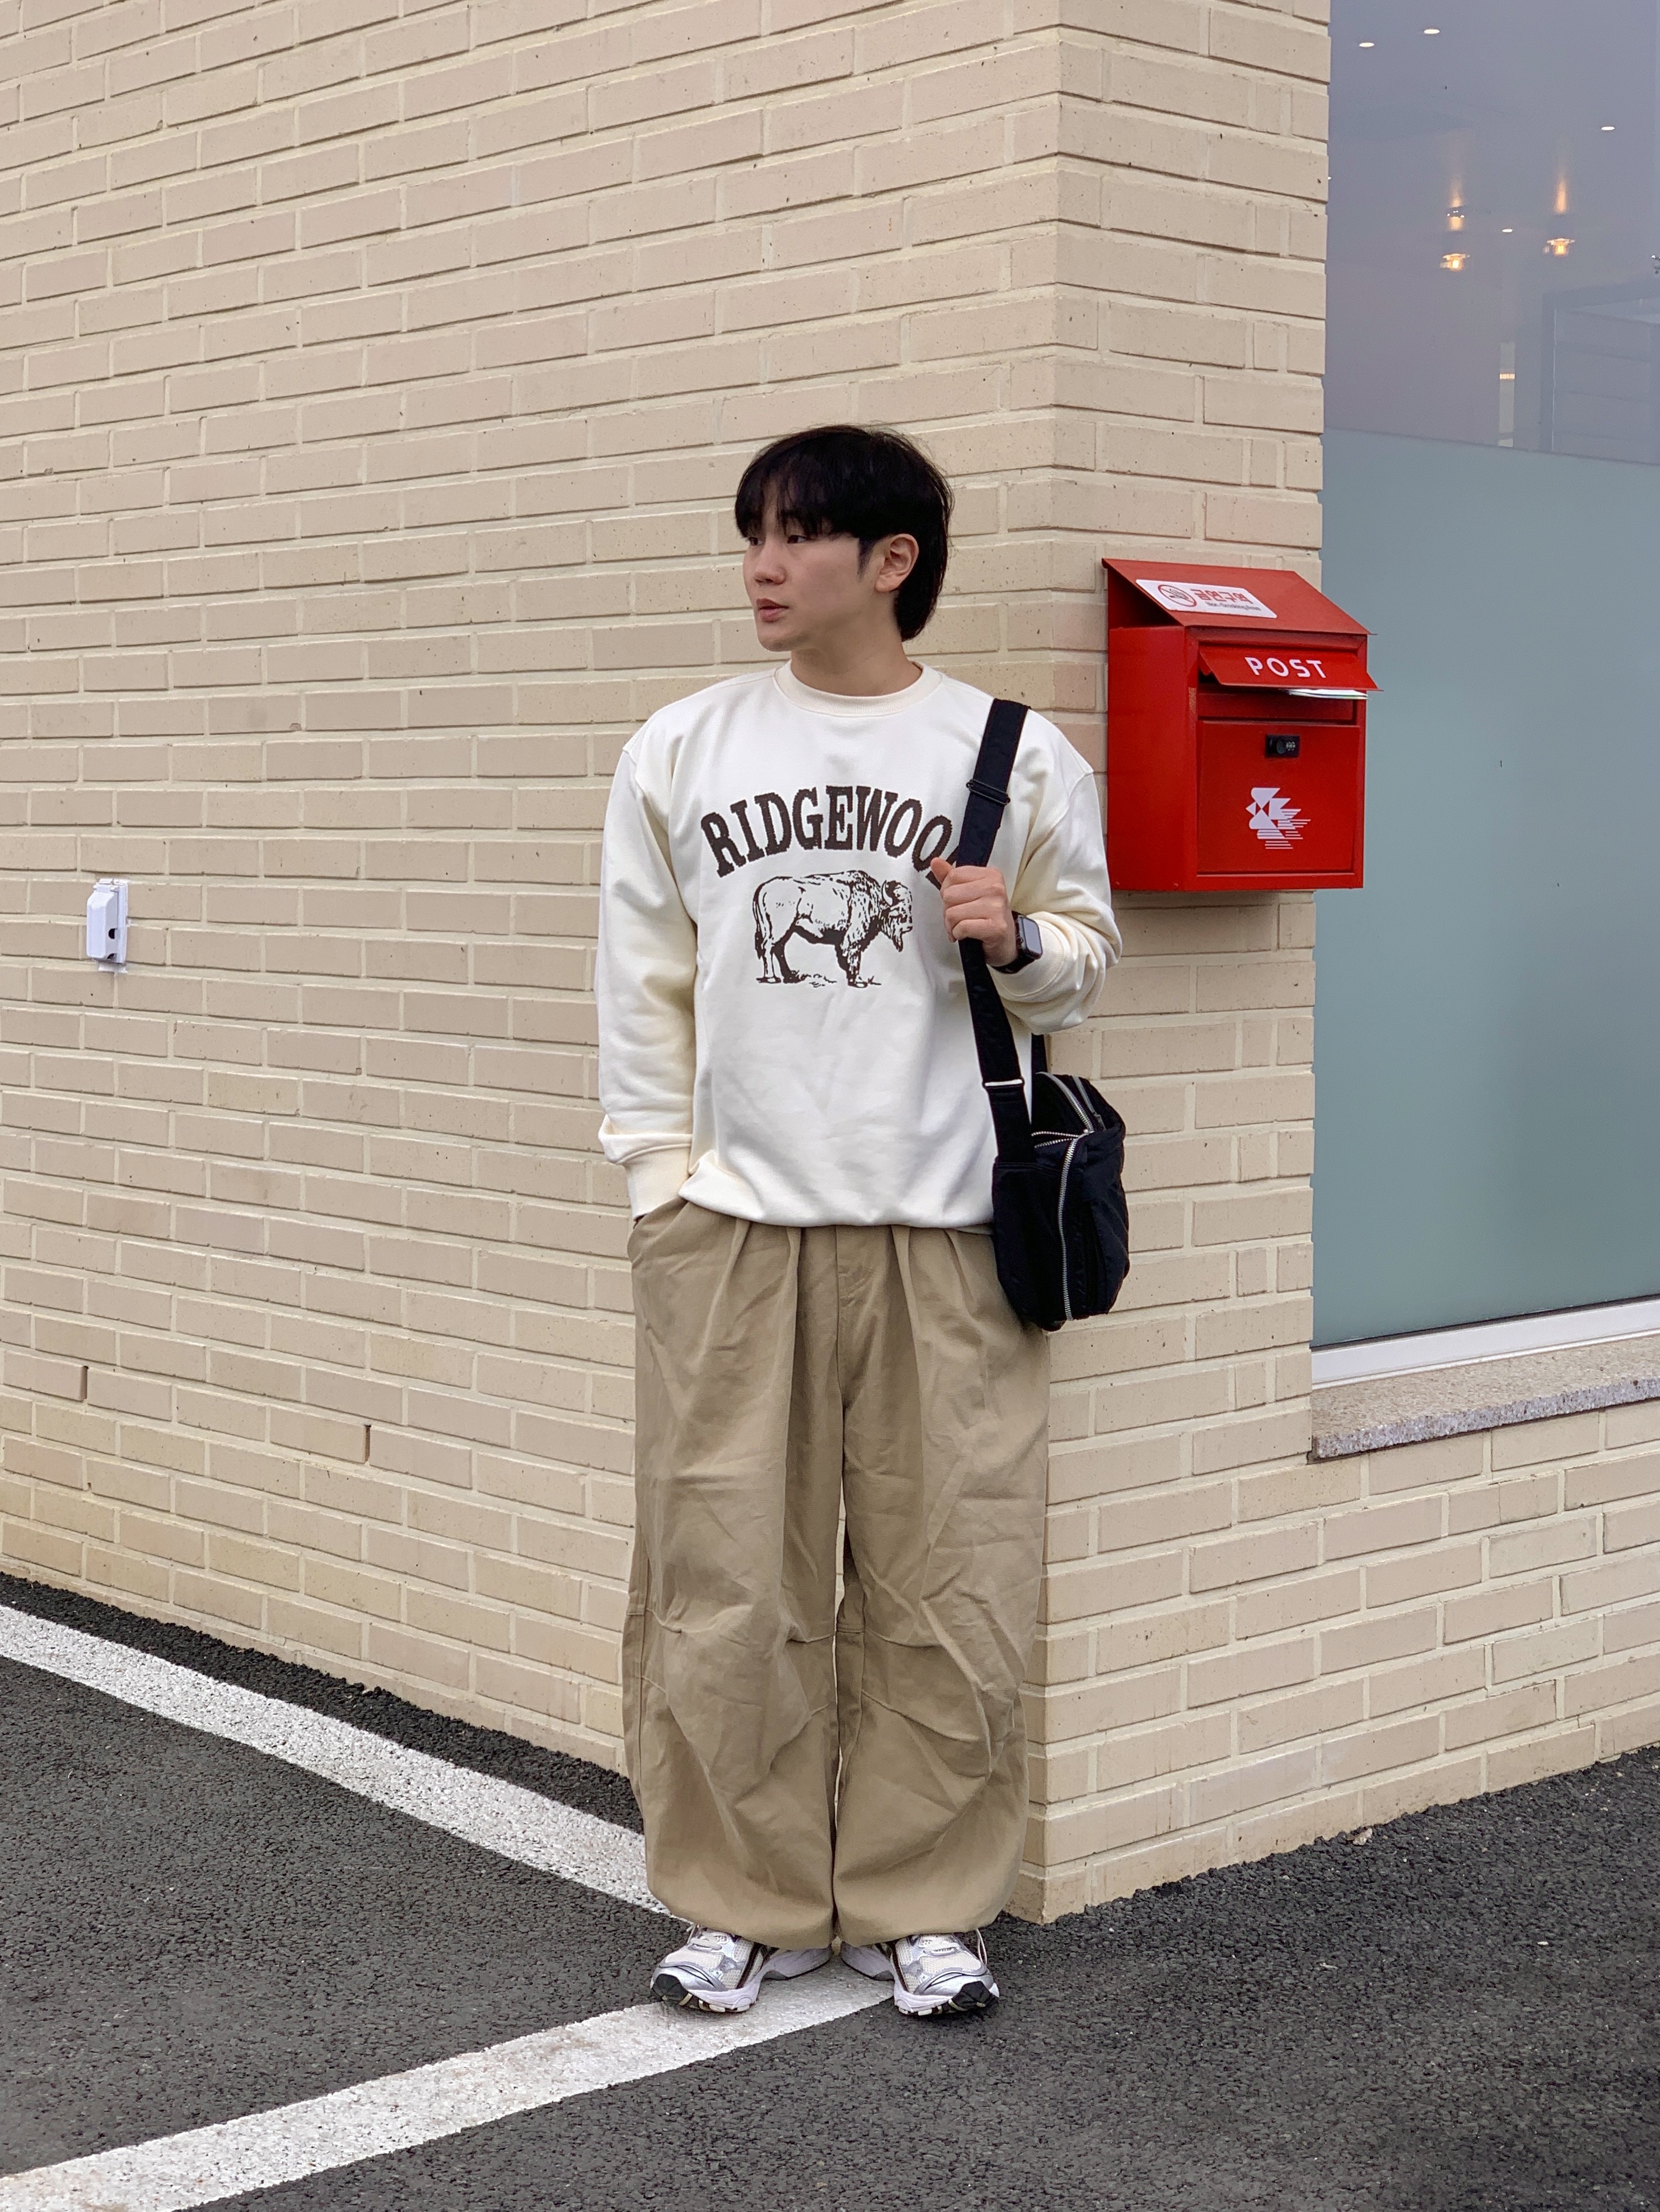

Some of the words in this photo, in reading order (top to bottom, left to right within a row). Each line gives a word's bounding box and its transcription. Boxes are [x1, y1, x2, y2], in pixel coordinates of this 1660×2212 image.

[1190, 589, 1253, 604] 금연구역
[1244, 657, 1326, 678] POST
[701, 785, 959, 891] RIDGEWOO
